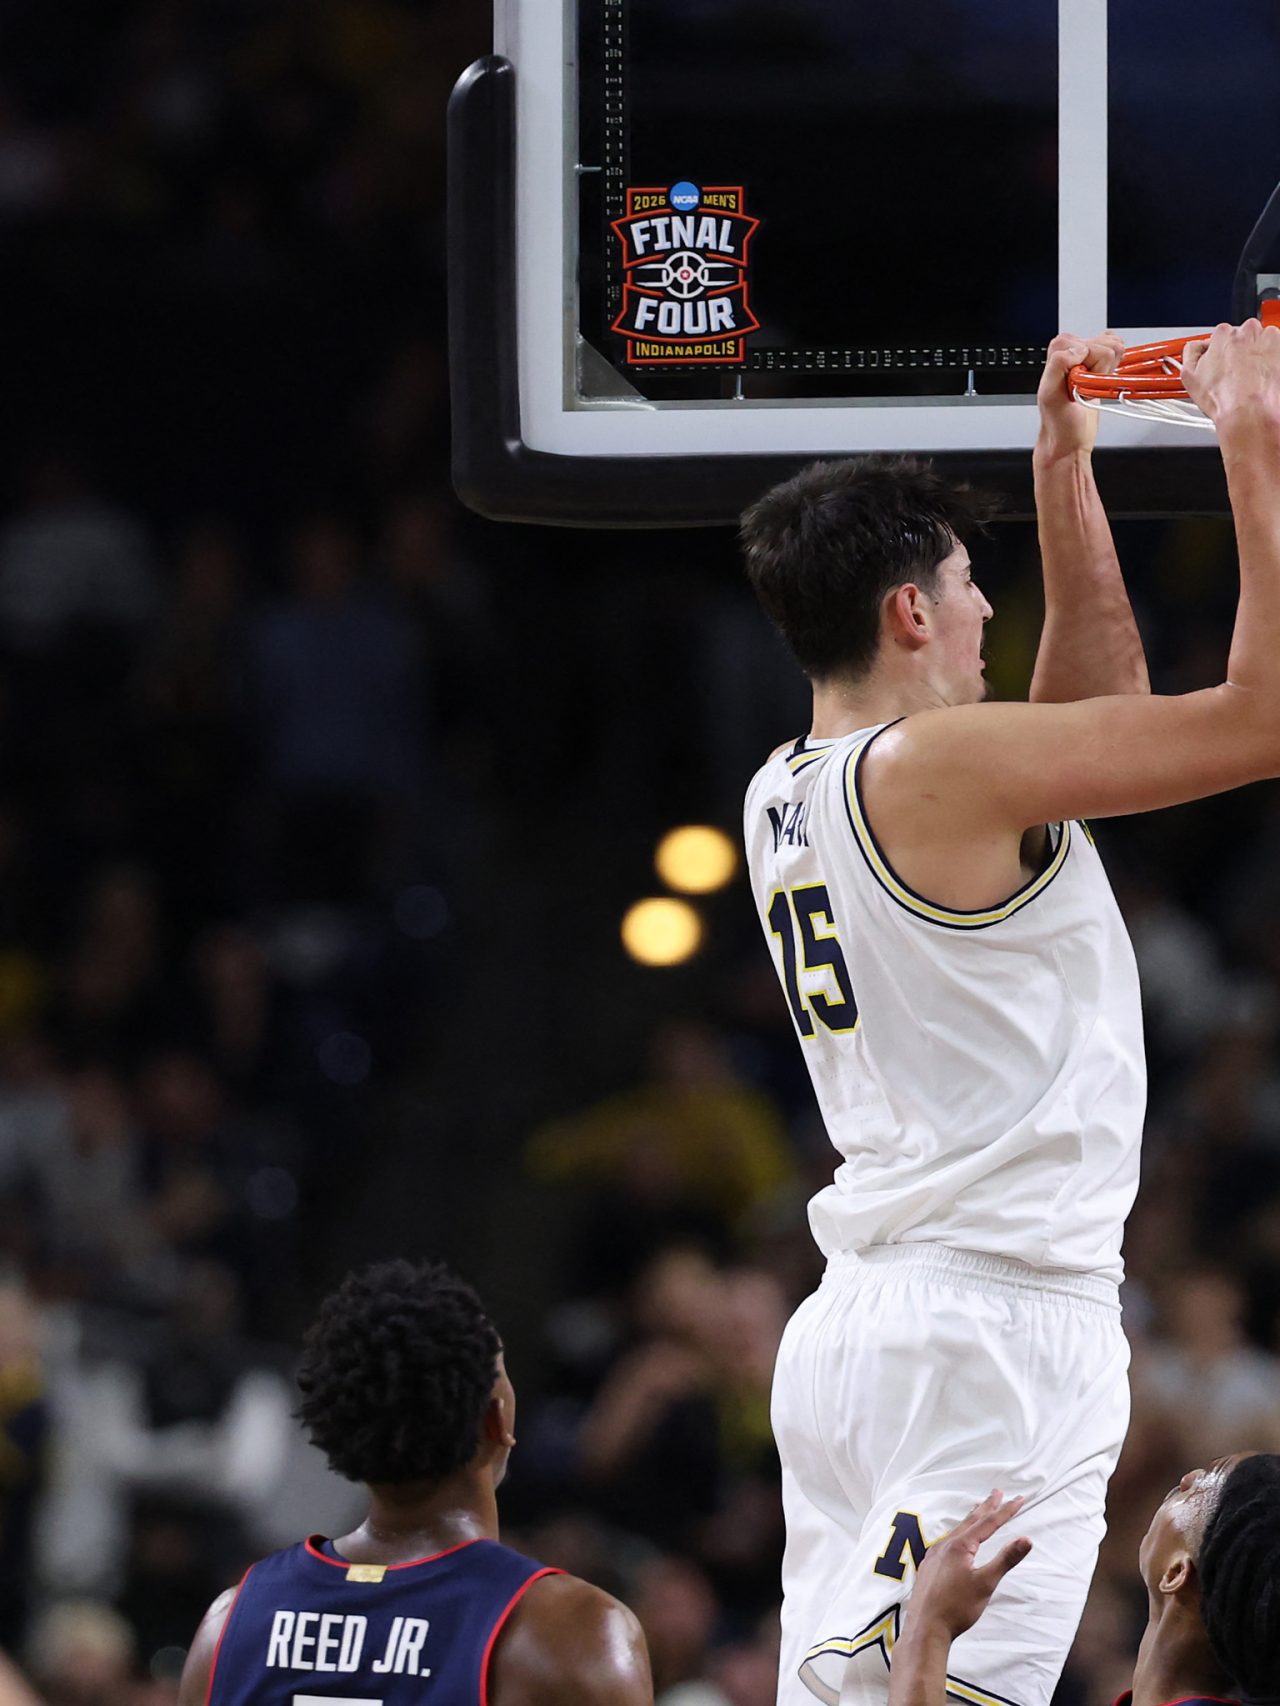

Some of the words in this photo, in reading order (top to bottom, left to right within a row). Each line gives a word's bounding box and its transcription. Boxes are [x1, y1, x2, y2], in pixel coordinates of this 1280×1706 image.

[634, 195, 666, 211] 2026
[672, 194, 699, 205] NCAA
[703, 194, 736, 209] MEN'S
[630, 215, 735, 256] FINAL
[634, 296, 736, 335] FOUR
[635, 340, 735, 357] INDIANAPOLIS
[766, 881, 861, 1042] 15
[265, 1610, 367, 1673] REED
[372, 1616, 431, 1678] JR.
